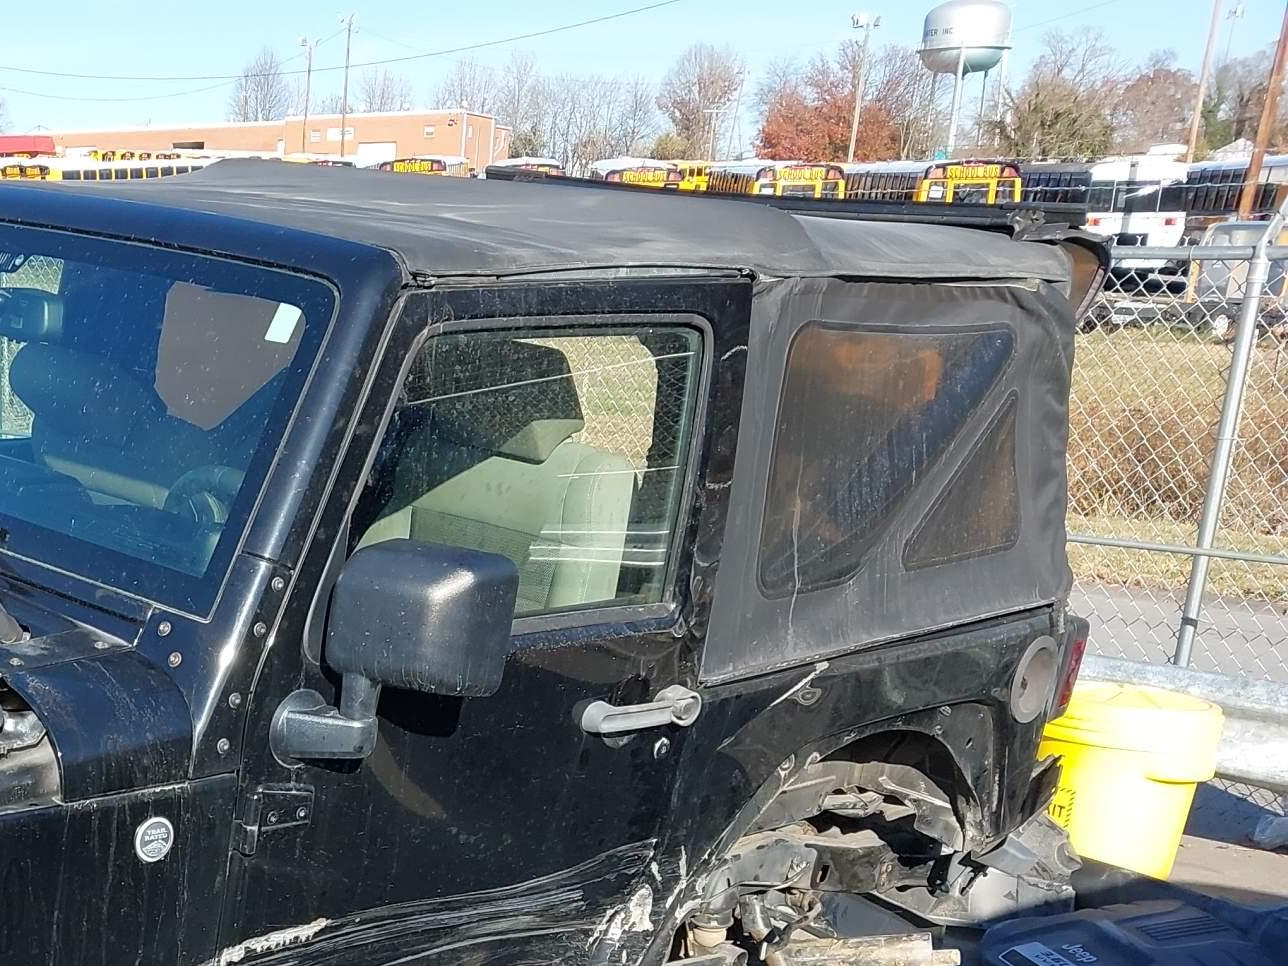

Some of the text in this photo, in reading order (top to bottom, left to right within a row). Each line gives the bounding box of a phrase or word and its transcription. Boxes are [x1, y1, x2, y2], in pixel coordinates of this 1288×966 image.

[949, 165, 998, 178] SCHOOL BUS
[1062, 943, 1097, 963] Jeep
